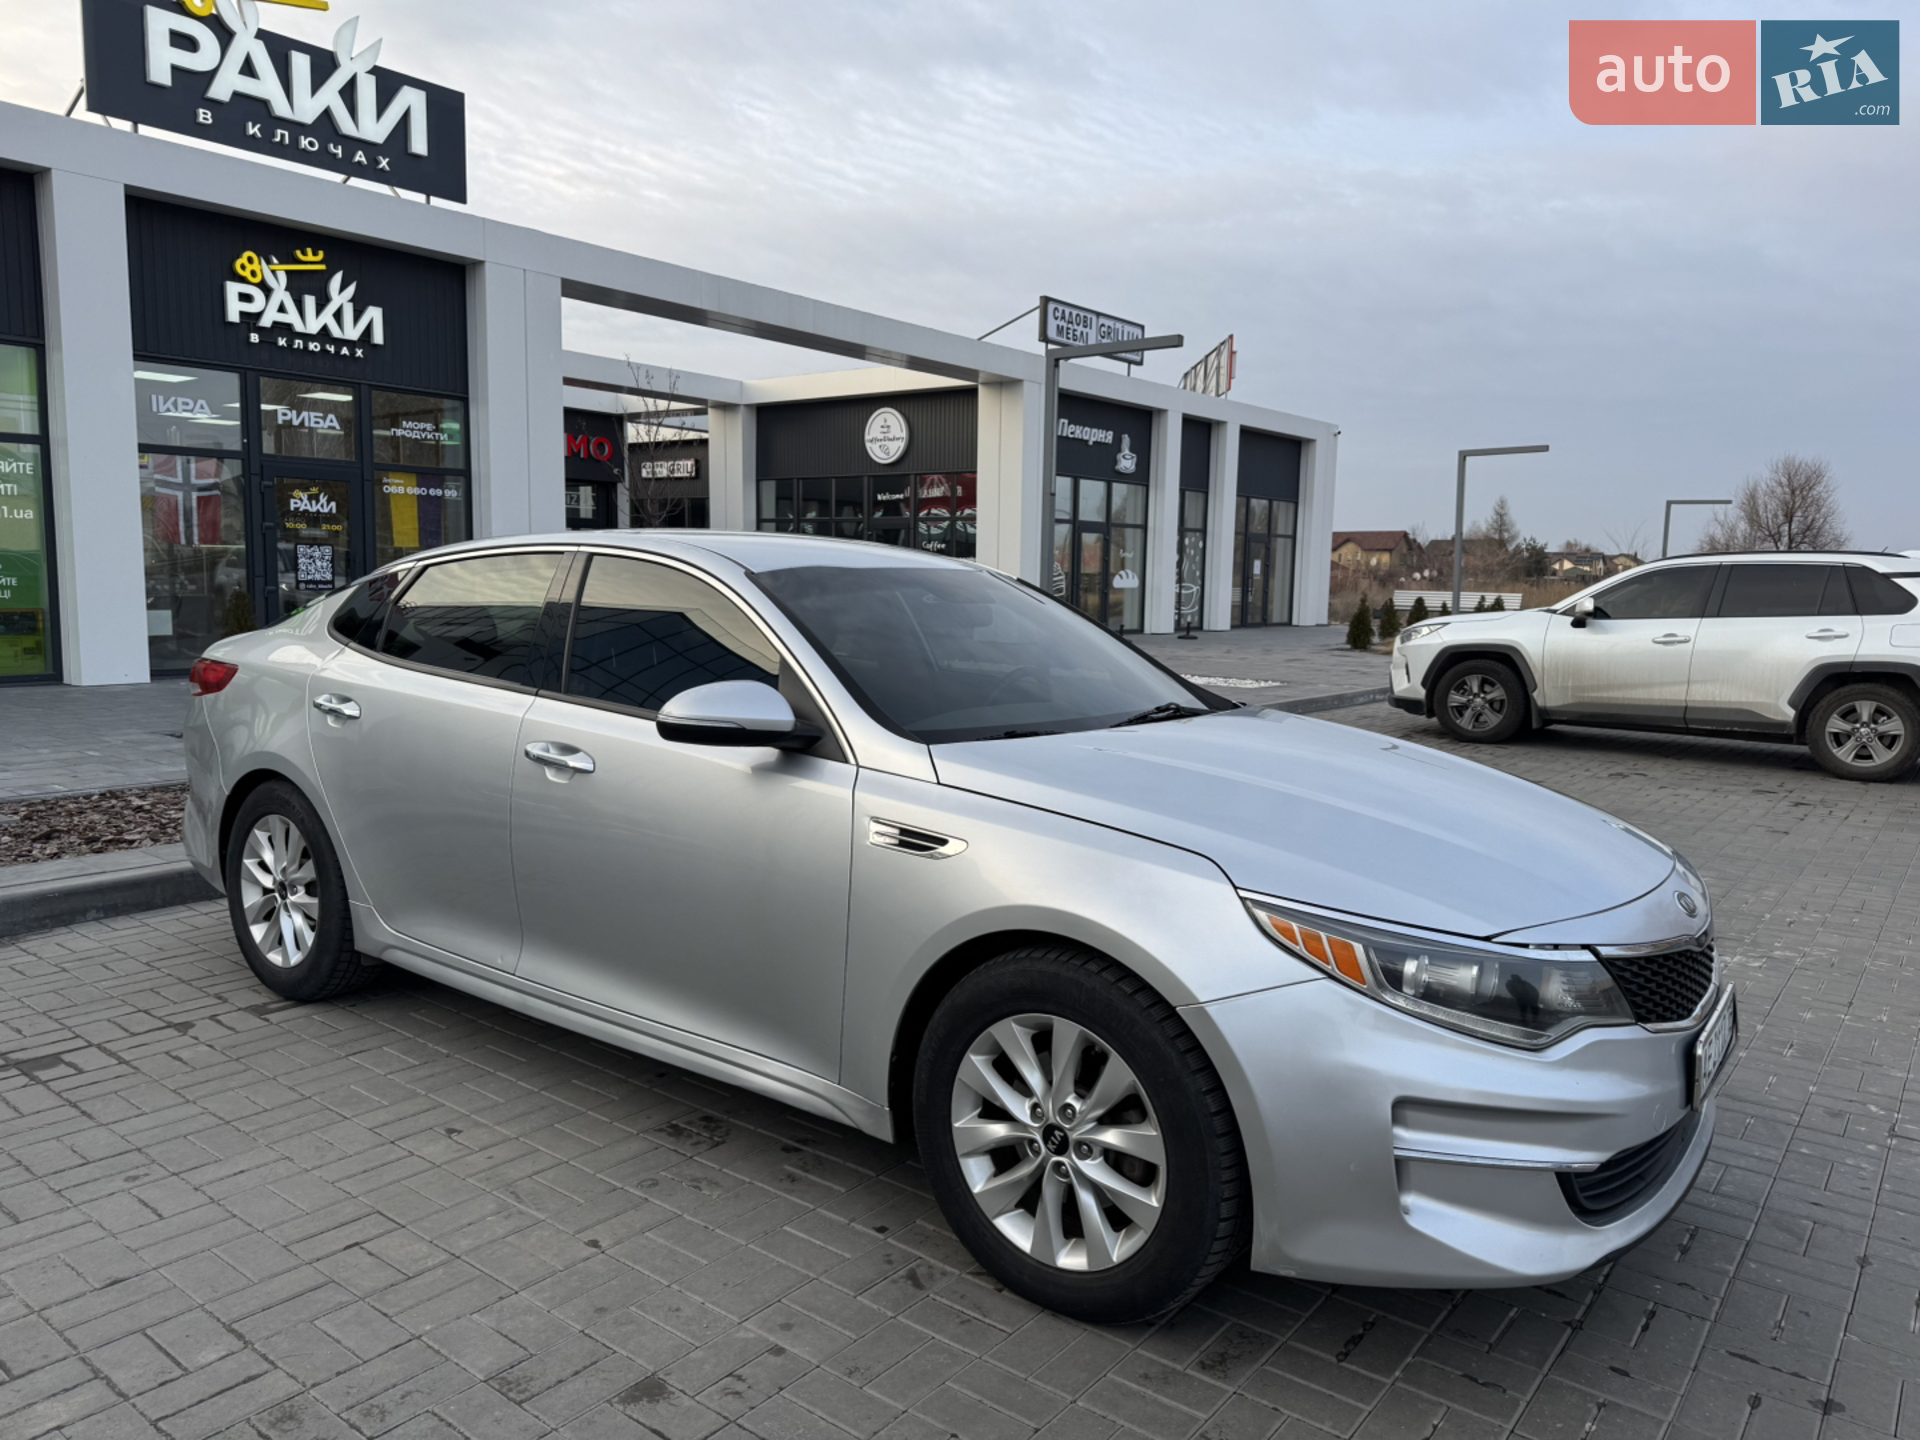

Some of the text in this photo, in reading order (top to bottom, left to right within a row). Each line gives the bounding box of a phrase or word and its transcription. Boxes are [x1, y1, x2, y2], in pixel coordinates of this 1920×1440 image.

[142, 3, 429, 157] РАКИ
[196, 108, 391, 172] В КЛЮЧАХ
[223, 279, 385, 345] РАКИ
[1052, 306, 1093, 330] САДОВІ
[249, 333, 364, 358] В КЛЮЧАХ
[1056, 324, 1089, 345] МЕБЛІ
[151, 394, 213, 417] ІКРА
[276, 408, 341, 430] РИБА
[390, 428, 449, 441] ПРОДУКТИ
[1057, 418, 1114, 446] Пекарня
[290, 498, 337, 514] РАКИ
[877, 491, 905, 501] Welcome
[0, 505, 35, 520] 1.ua
[922, 541, 947, 551] Coffee
[1046, 1130, 1065, 1152] KIA
